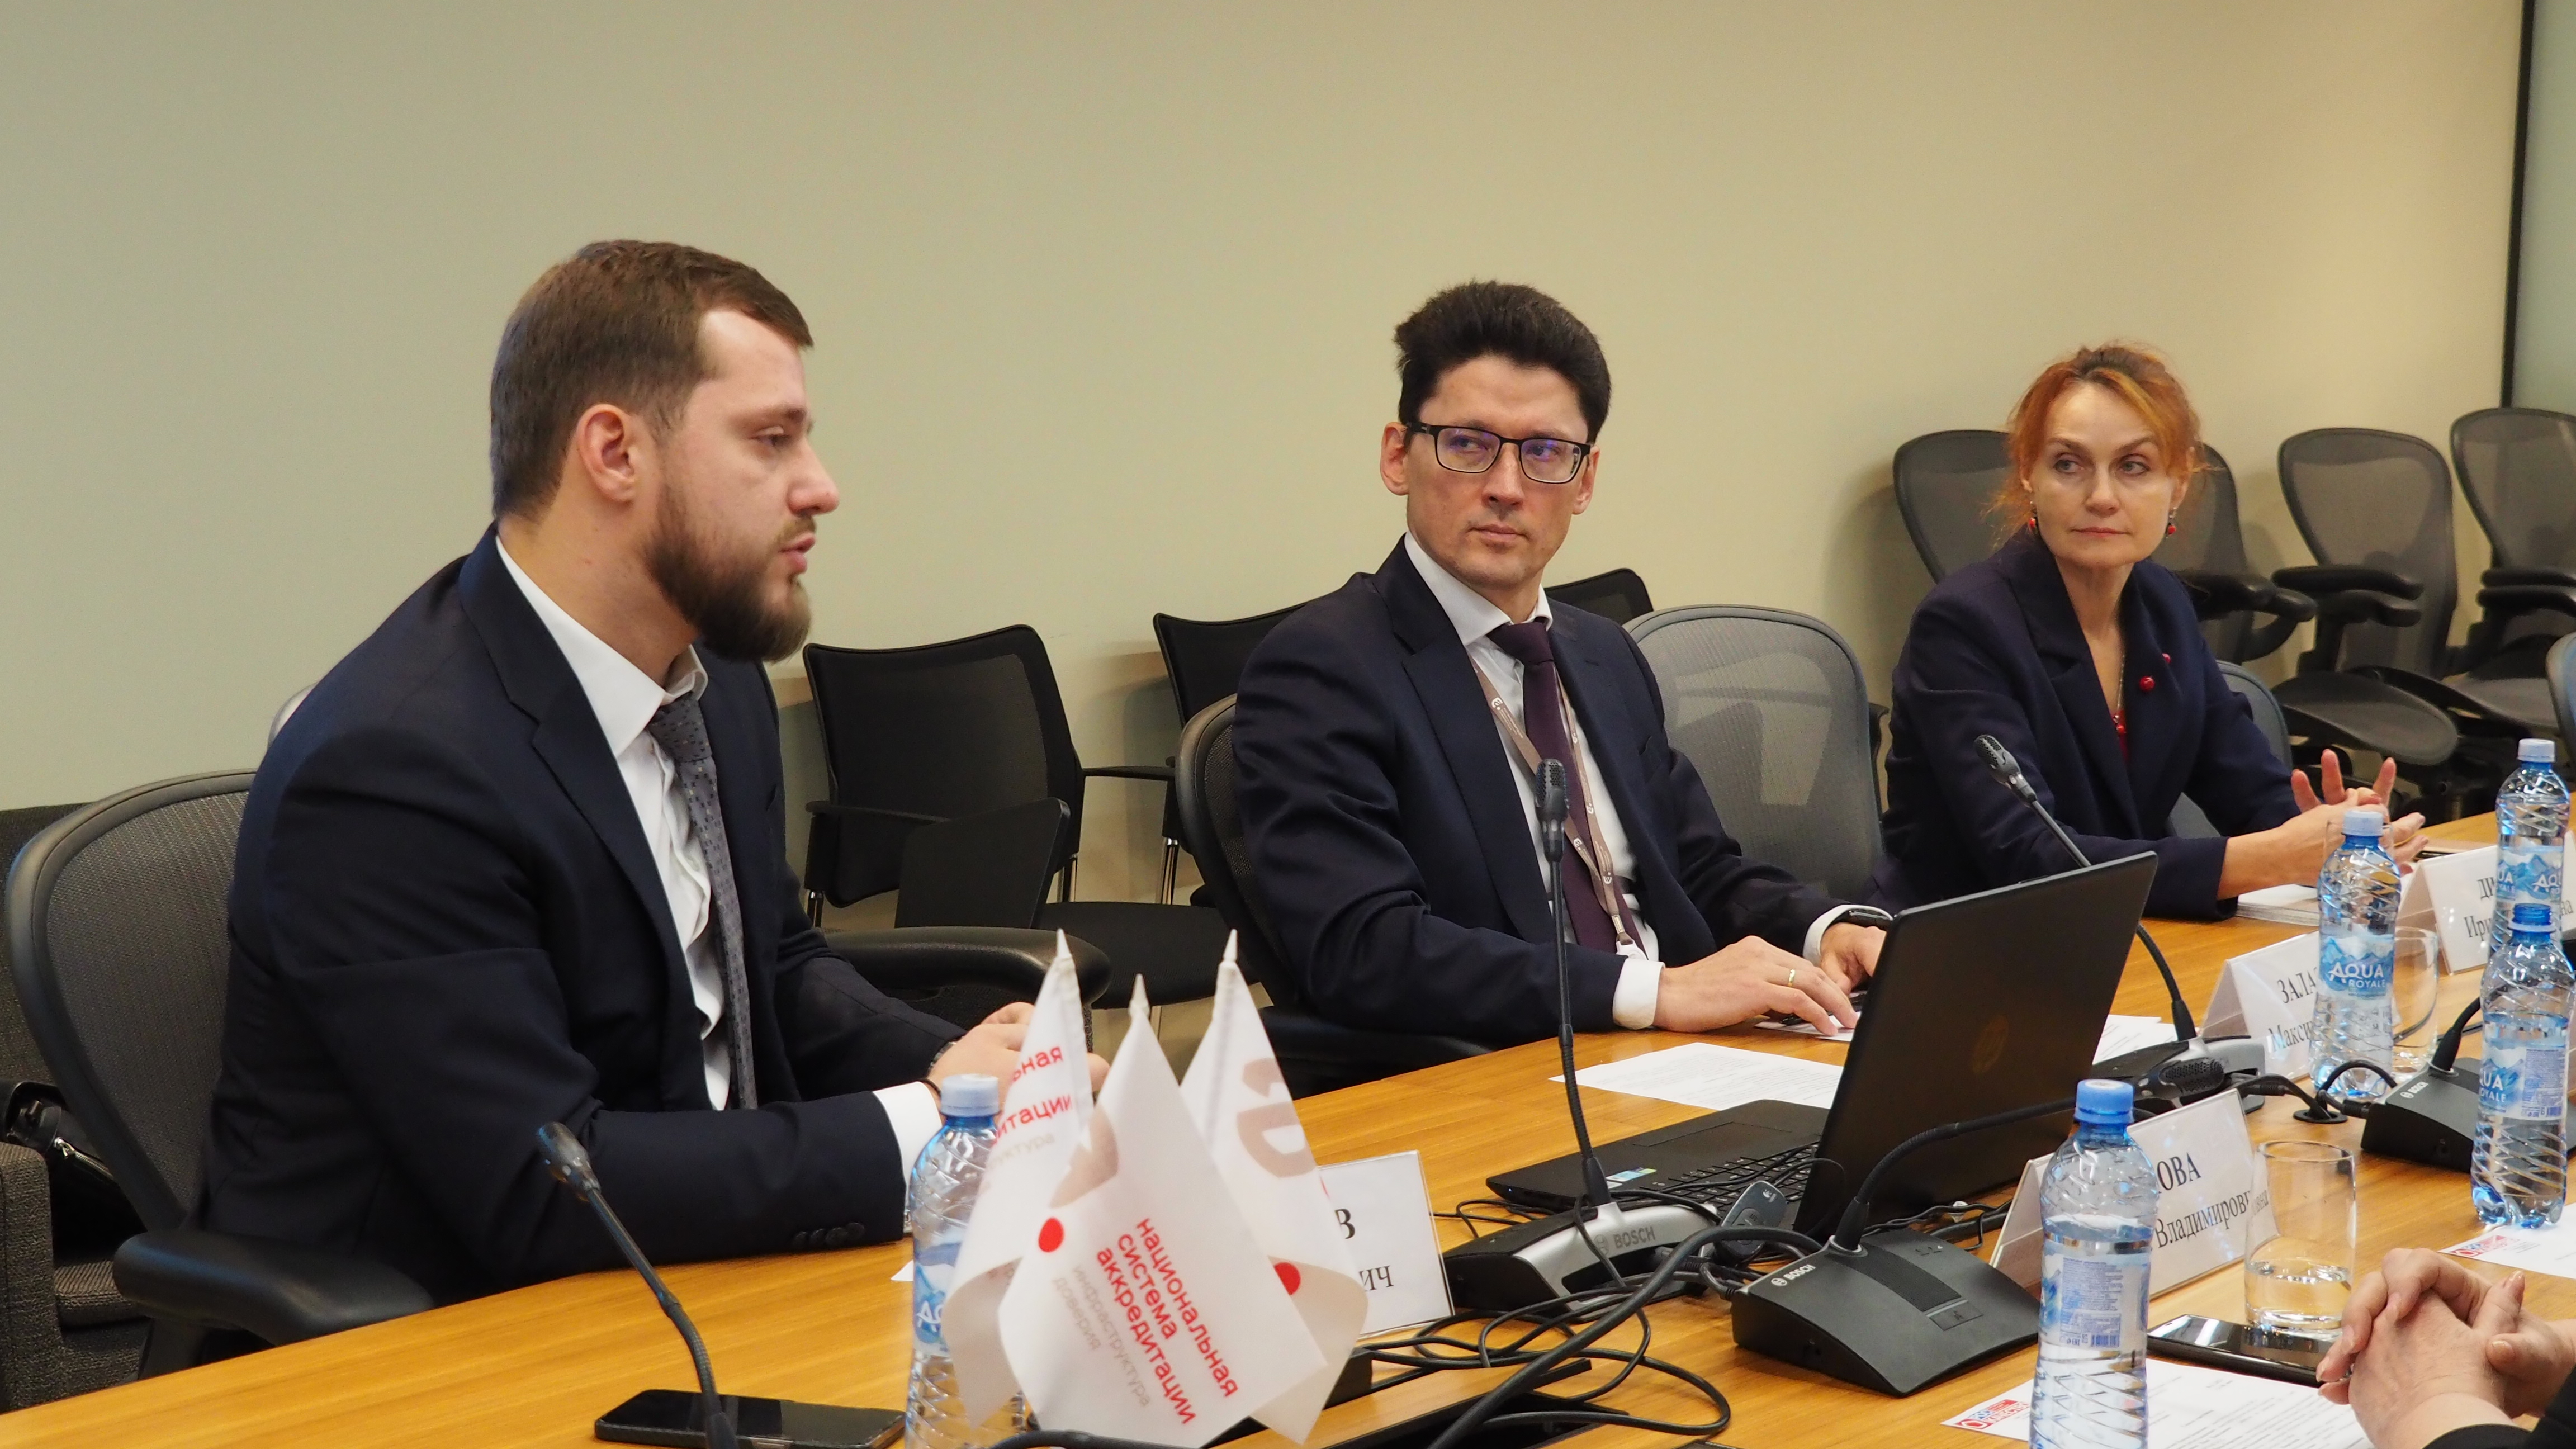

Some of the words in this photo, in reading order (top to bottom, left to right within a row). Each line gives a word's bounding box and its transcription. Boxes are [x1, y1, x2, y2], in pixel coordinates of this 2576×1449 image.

[2277, 967, 2318, 1003] ЗАЛА
[2327, 962, 2384, 983] AQUA
[2348, 979, 2386, 988] ROYALE
[992, 1095, 1072, 1145] итации
[2157, 1152, 2202, 1194] ОВА
[1613, 1226, 1656, 1249] BOSCH
[1119, 1234, 1178, 1340] система
[1783, 1264, 1816, 1280] BOSCH
[1052, 1277, 1102, 1351] доверия
[1137, 1218, 1239, 1398] национальная
[1073, 1265, 1150, 1407] инфраструктура
[1097, 1247, 1196, 1424] аккредитации
